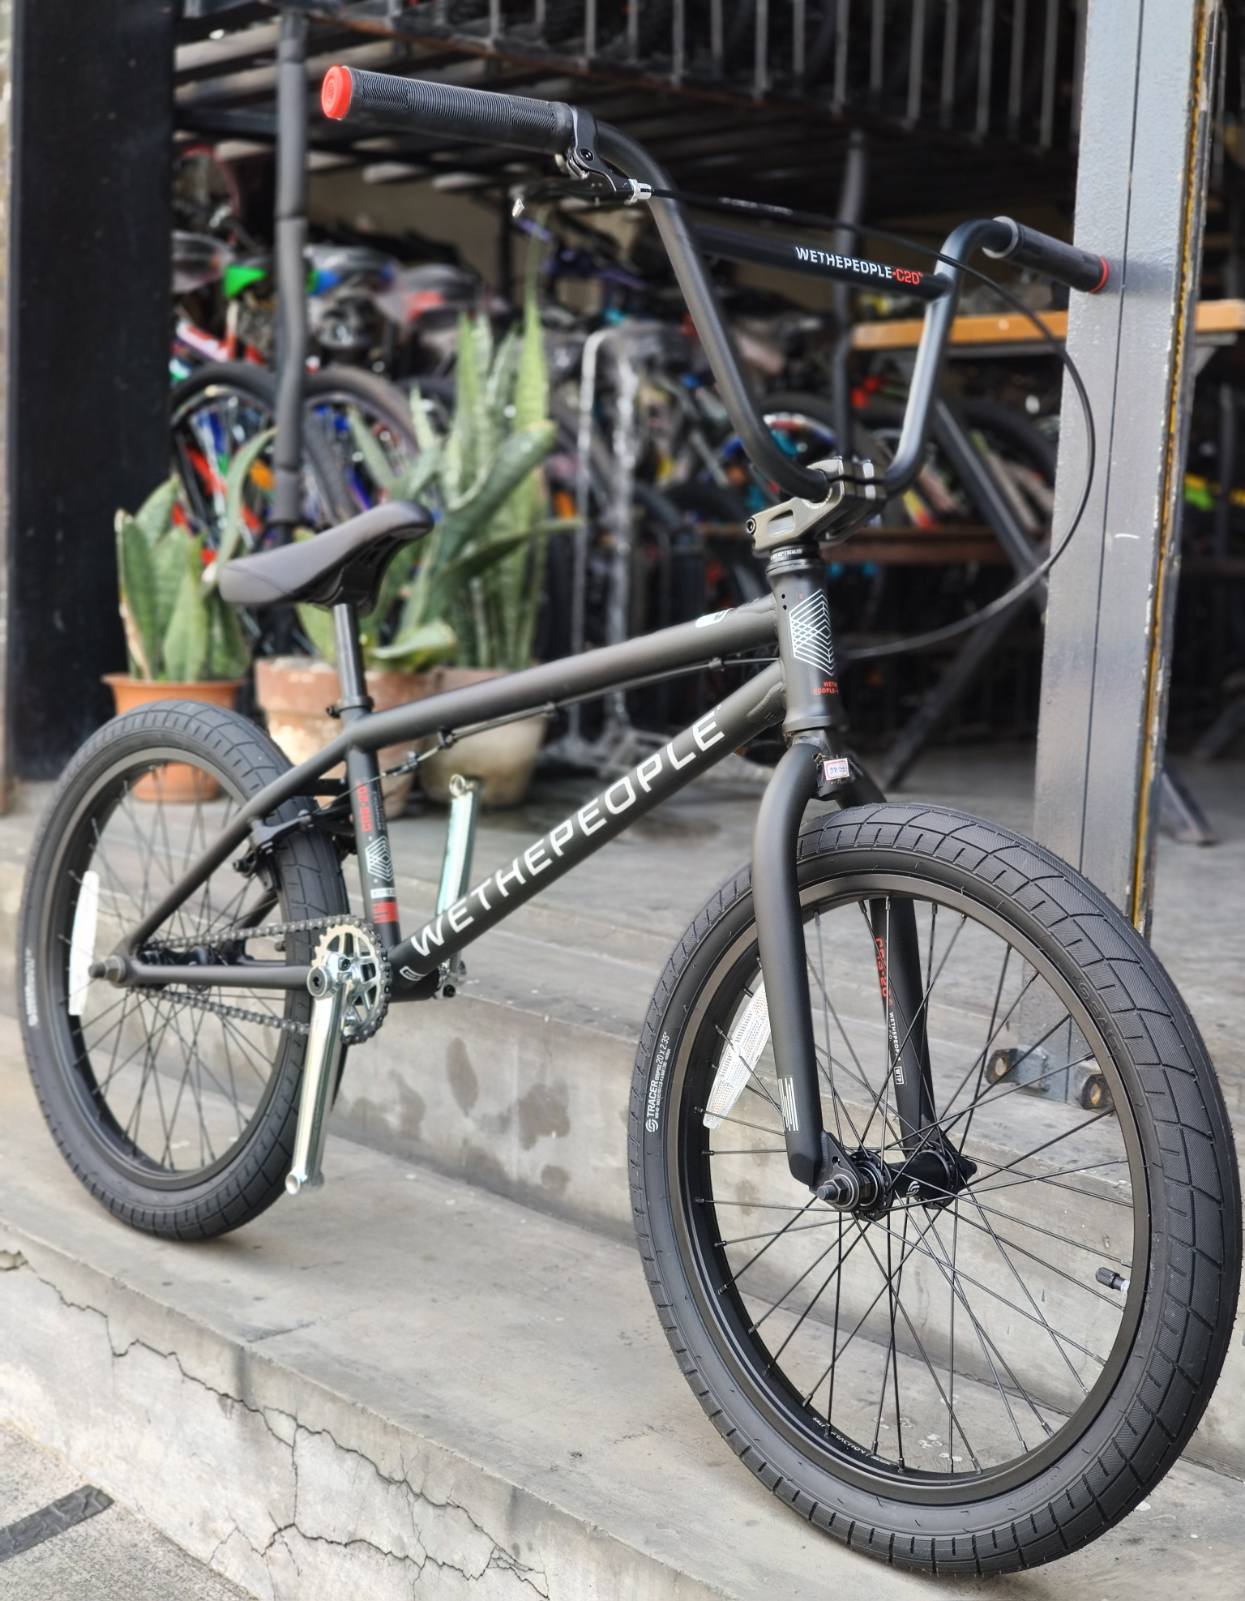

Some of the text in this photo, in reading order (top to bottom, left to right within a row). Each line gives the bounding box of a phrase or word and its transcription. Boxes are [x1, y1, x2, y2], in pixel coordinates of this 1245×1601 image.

[411, 709, 725, 957] WETHEPEOPLE
[889, 1011, 901, 1061] WETHEPEOP
[647, 1079, 658, 1117] TRACER
